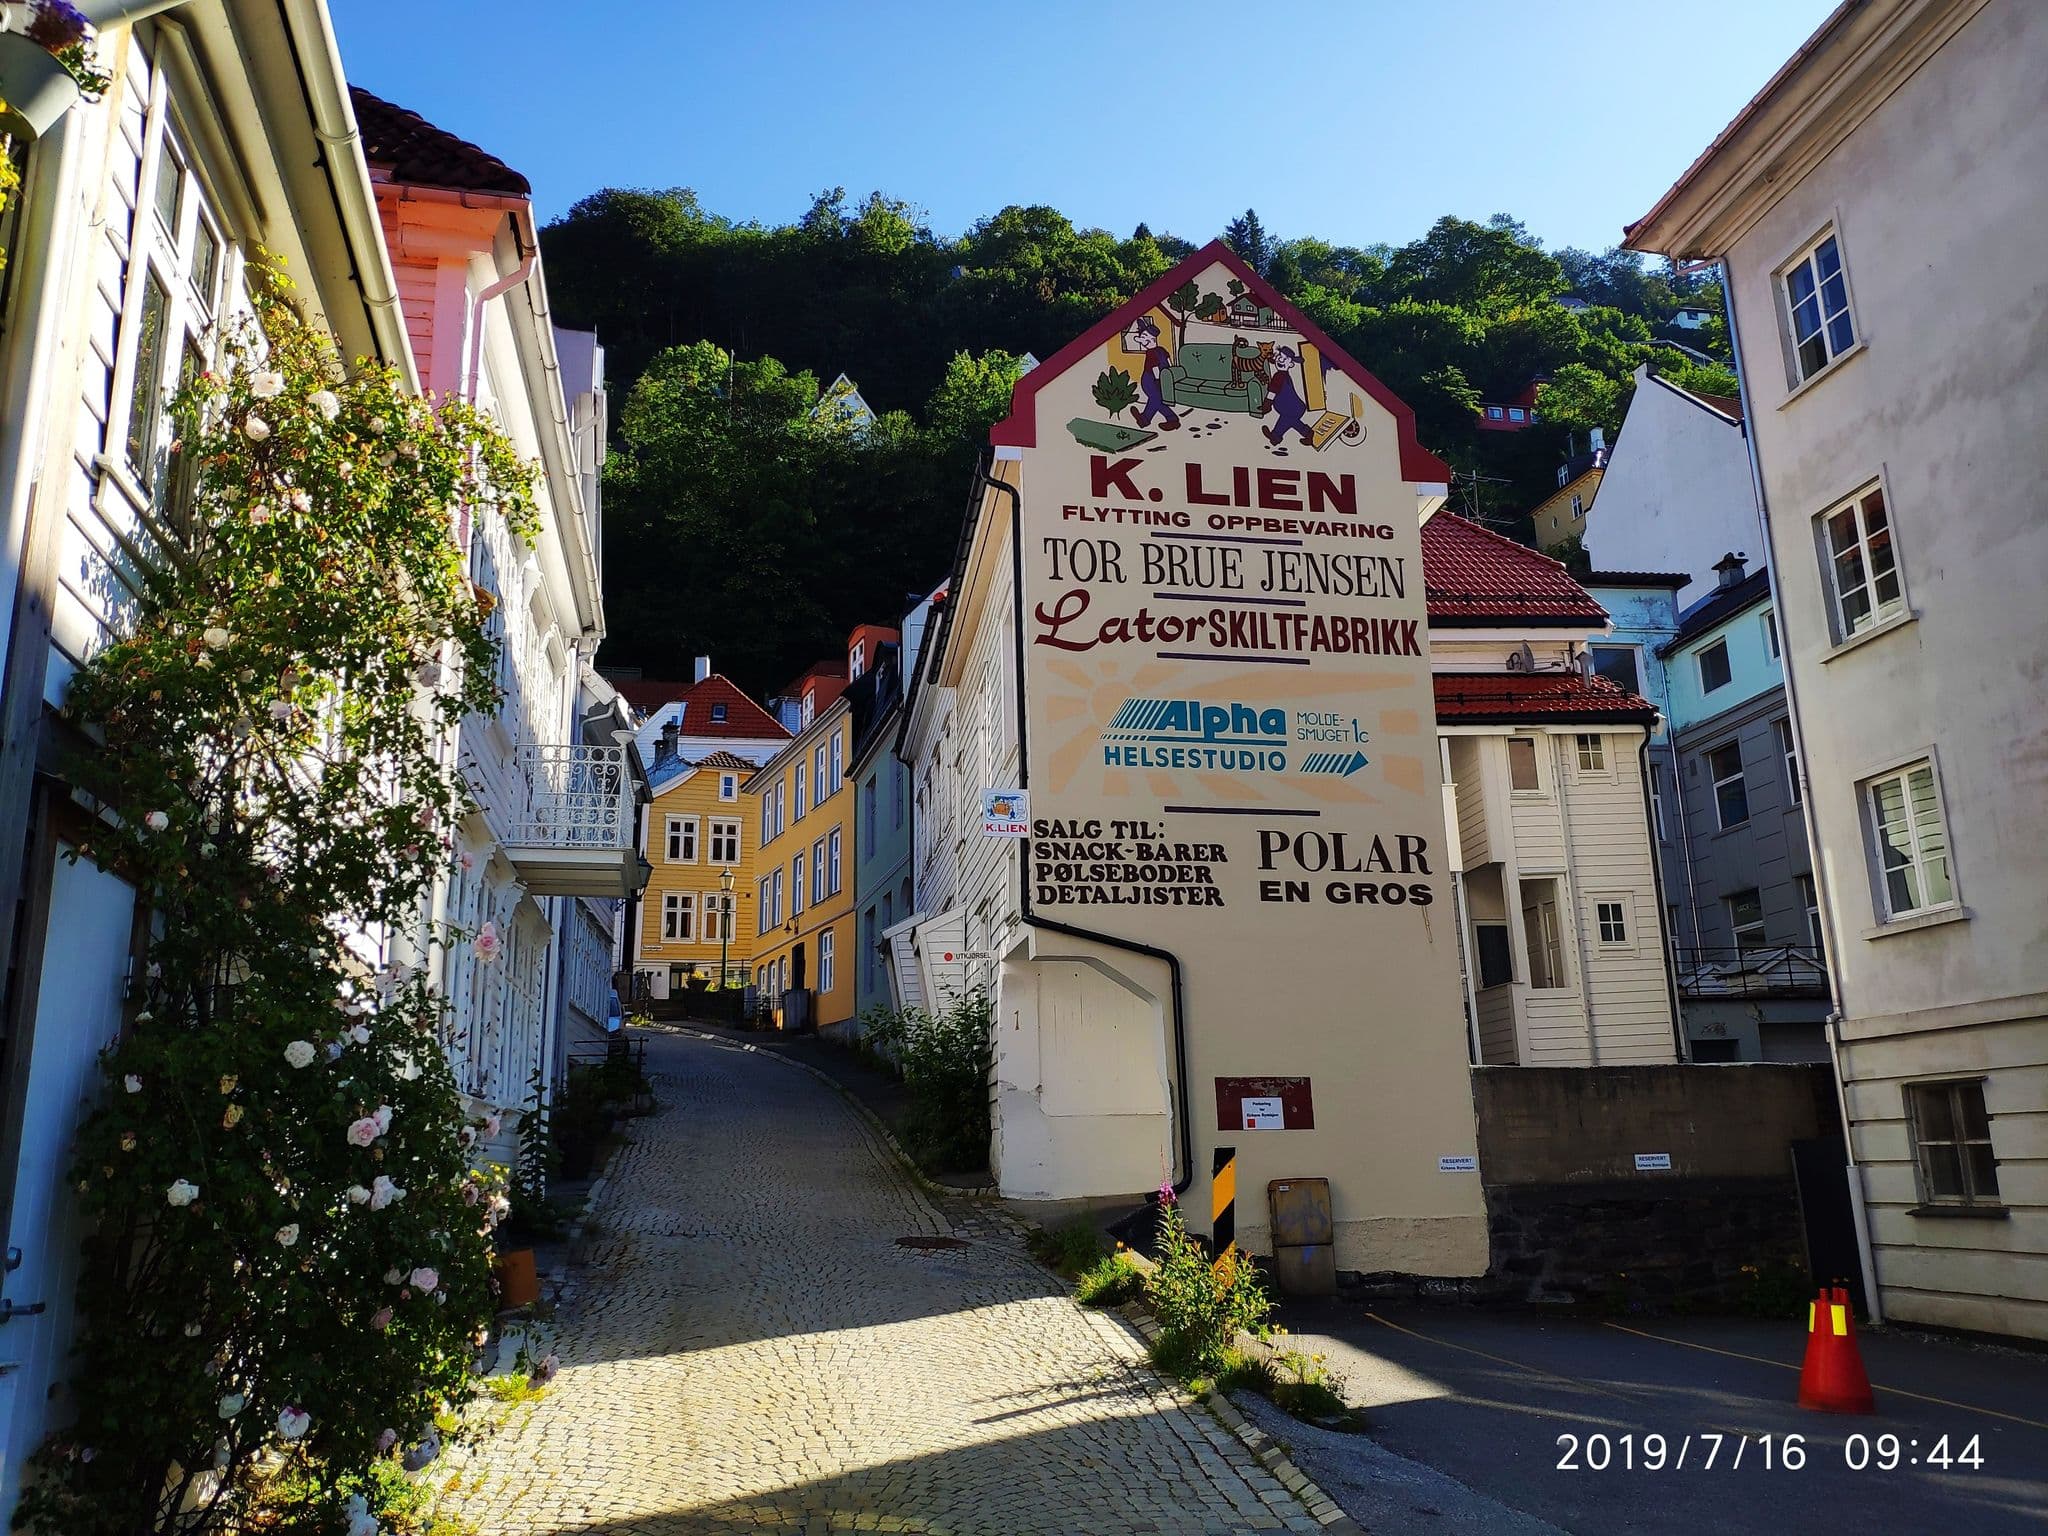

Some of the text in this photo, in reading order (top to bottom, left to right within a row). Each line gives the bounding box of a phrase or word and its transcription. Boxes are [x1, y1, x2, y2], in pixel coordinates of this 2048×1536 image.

[1090, 454, 1357, 515] K. LIEN
[1062, 505, 1394, 540] FLYTTING OPPBEVARING
[1043, 537, 1405, 599] TOR BRUE JENSEN
[1034, 588, 1422, 657] Lator SKILTFABRIKK
[1157, 700, 1287, 739] Alpha
[1296, 712, 1344, 726] MOLDE-
[1297, 728, 1350, 742] SMUGET
[1104, 746, 1286, 772] HELSESTUDIO
[1033, 819, 1165, 840] SALG TIL:
[1034, 842, 1228, 863] SNACK-BARER
[1257, 829, 1433, 875] POLAR
[1035, 863, 1214, 884] PØLSEBODER
[1036, 885, 1225, 907] DETALJISTER
[1259, 880, 1433, 906] EN GROS
[956, 952, 991, 960] UTKJØRSEL
